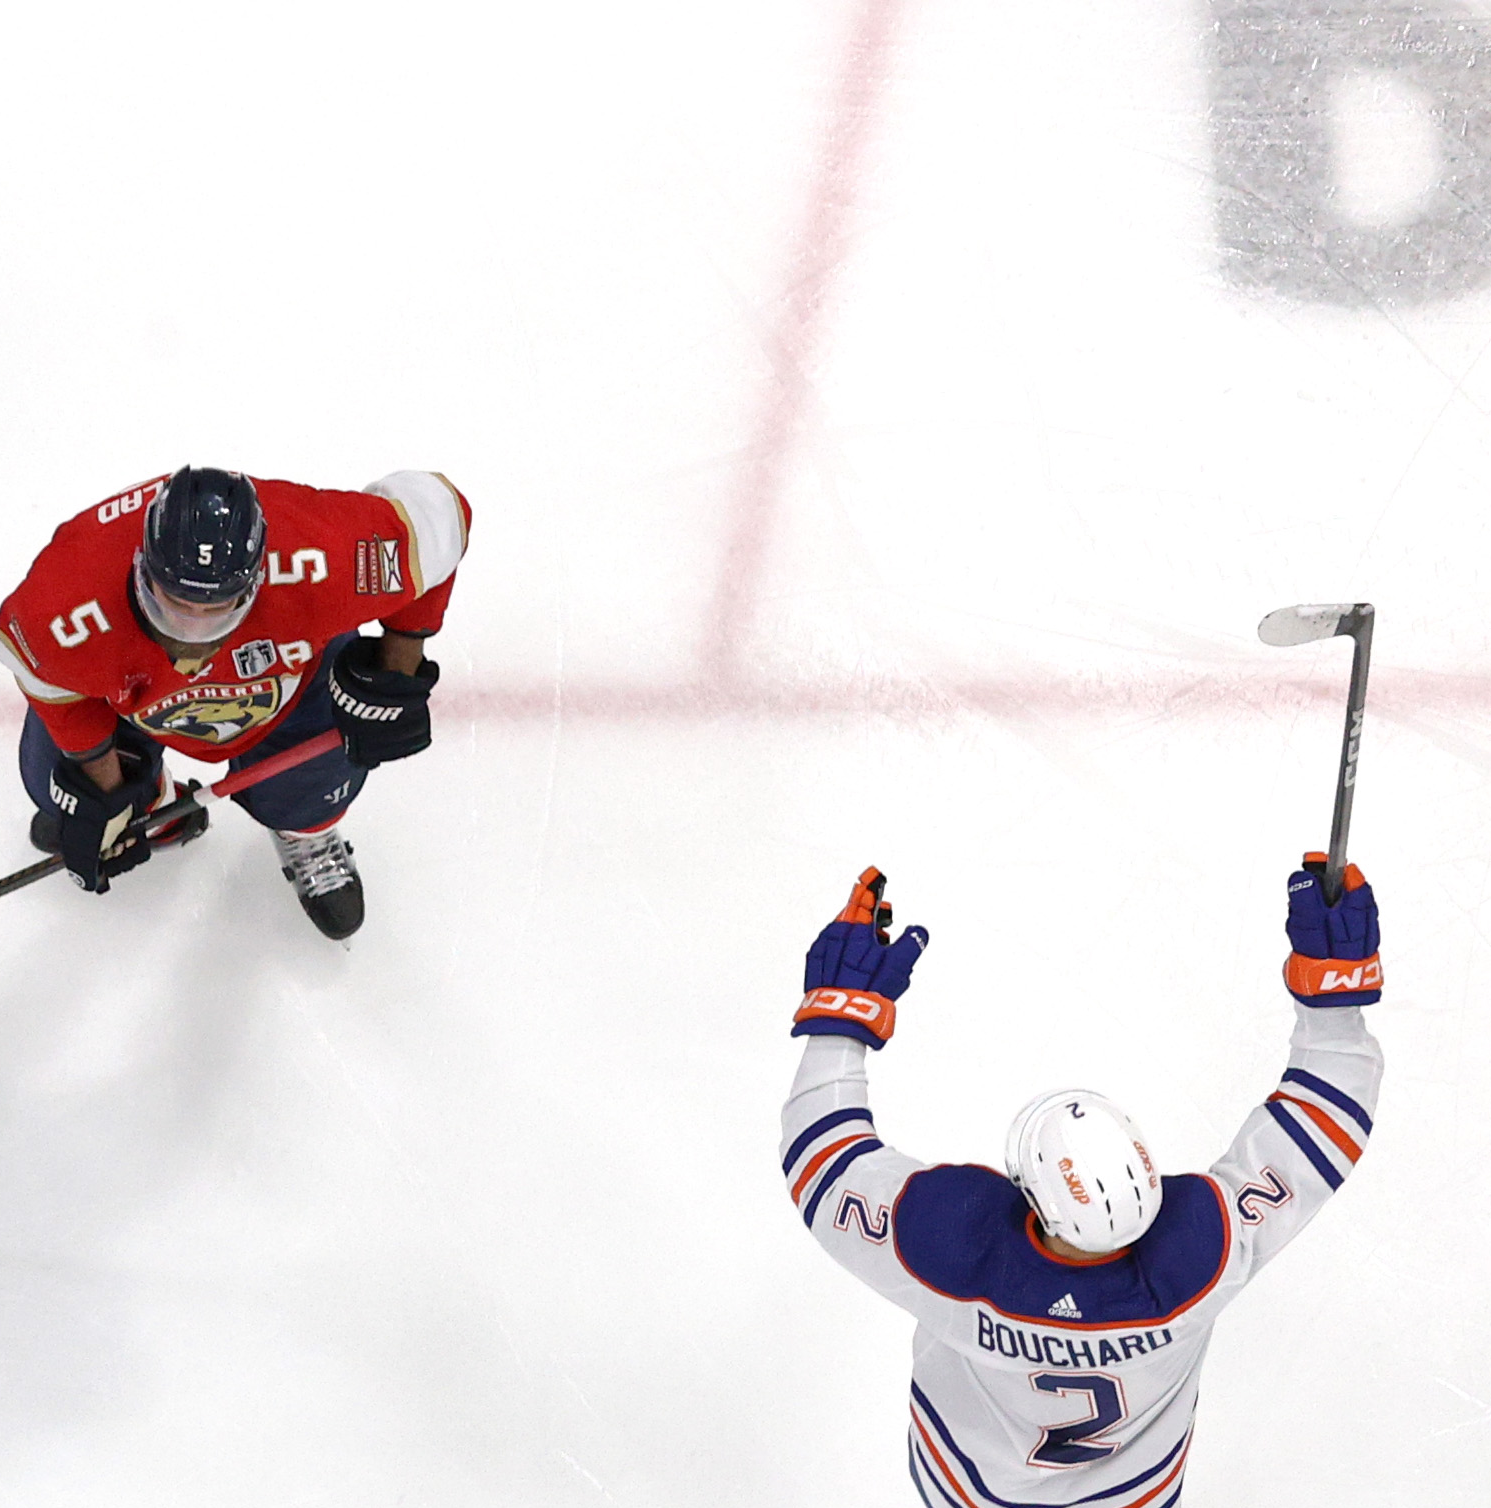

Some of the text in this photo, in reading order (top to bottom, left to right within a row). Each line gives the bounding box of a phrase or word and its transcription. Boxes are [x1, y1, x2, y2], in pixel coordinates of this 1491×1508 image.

[198, 544, 214, 565] 5
[268, 548, 329, 586] 5
[49, 598, 113, 649] 5
[147, 683, 264, 717] PANTHERS
[1065, 1101, 1086, 1119] 2
[832, 1189, 893, 1247] 2
[1236, 1165, 1295, 1227] 2
[1048, 1306, 1082, 1320] adidas
[978, 1308, 1173, 1369] BOUCHARD
[1026, 1369, 1129, 1470] 2
